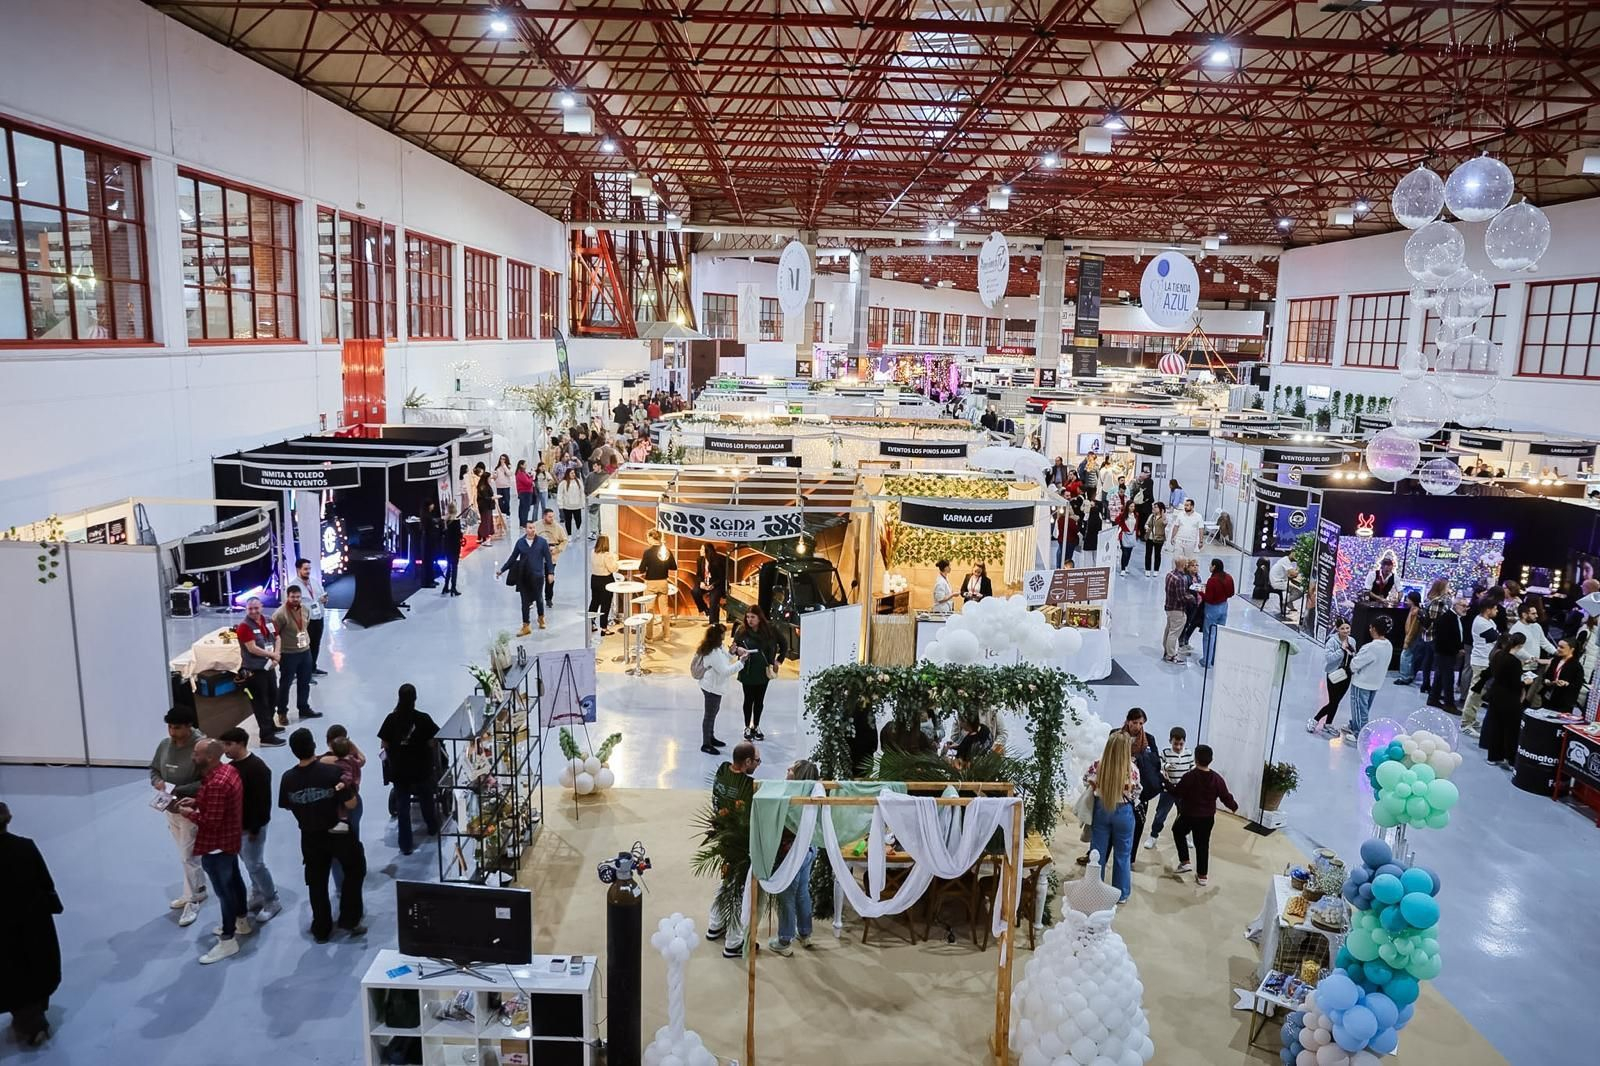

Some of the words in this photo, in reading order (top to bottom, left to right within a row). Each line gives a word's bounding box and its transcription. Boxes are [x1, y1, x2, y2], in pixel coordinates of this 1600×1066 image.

[1164, 282, 1171, 292] LA
[1172, 282, 1191, 293] TIENDA
[1163, 293, 1189, 312] AZUL
[711, 441, 732, 449] EVENTOS
[887, 446, 911, 454] EVENTOS
[261, 470, 285, 478] INMITA
[293, 471, 325, 479] TOLEDO
[261, 478, 292, 486] ENVIDIAZ
[293, 479, 328, 487] EVENTOS
[943, 513, 973, 523] KARMA
[973, 513, 993, 523] CAFÉ
